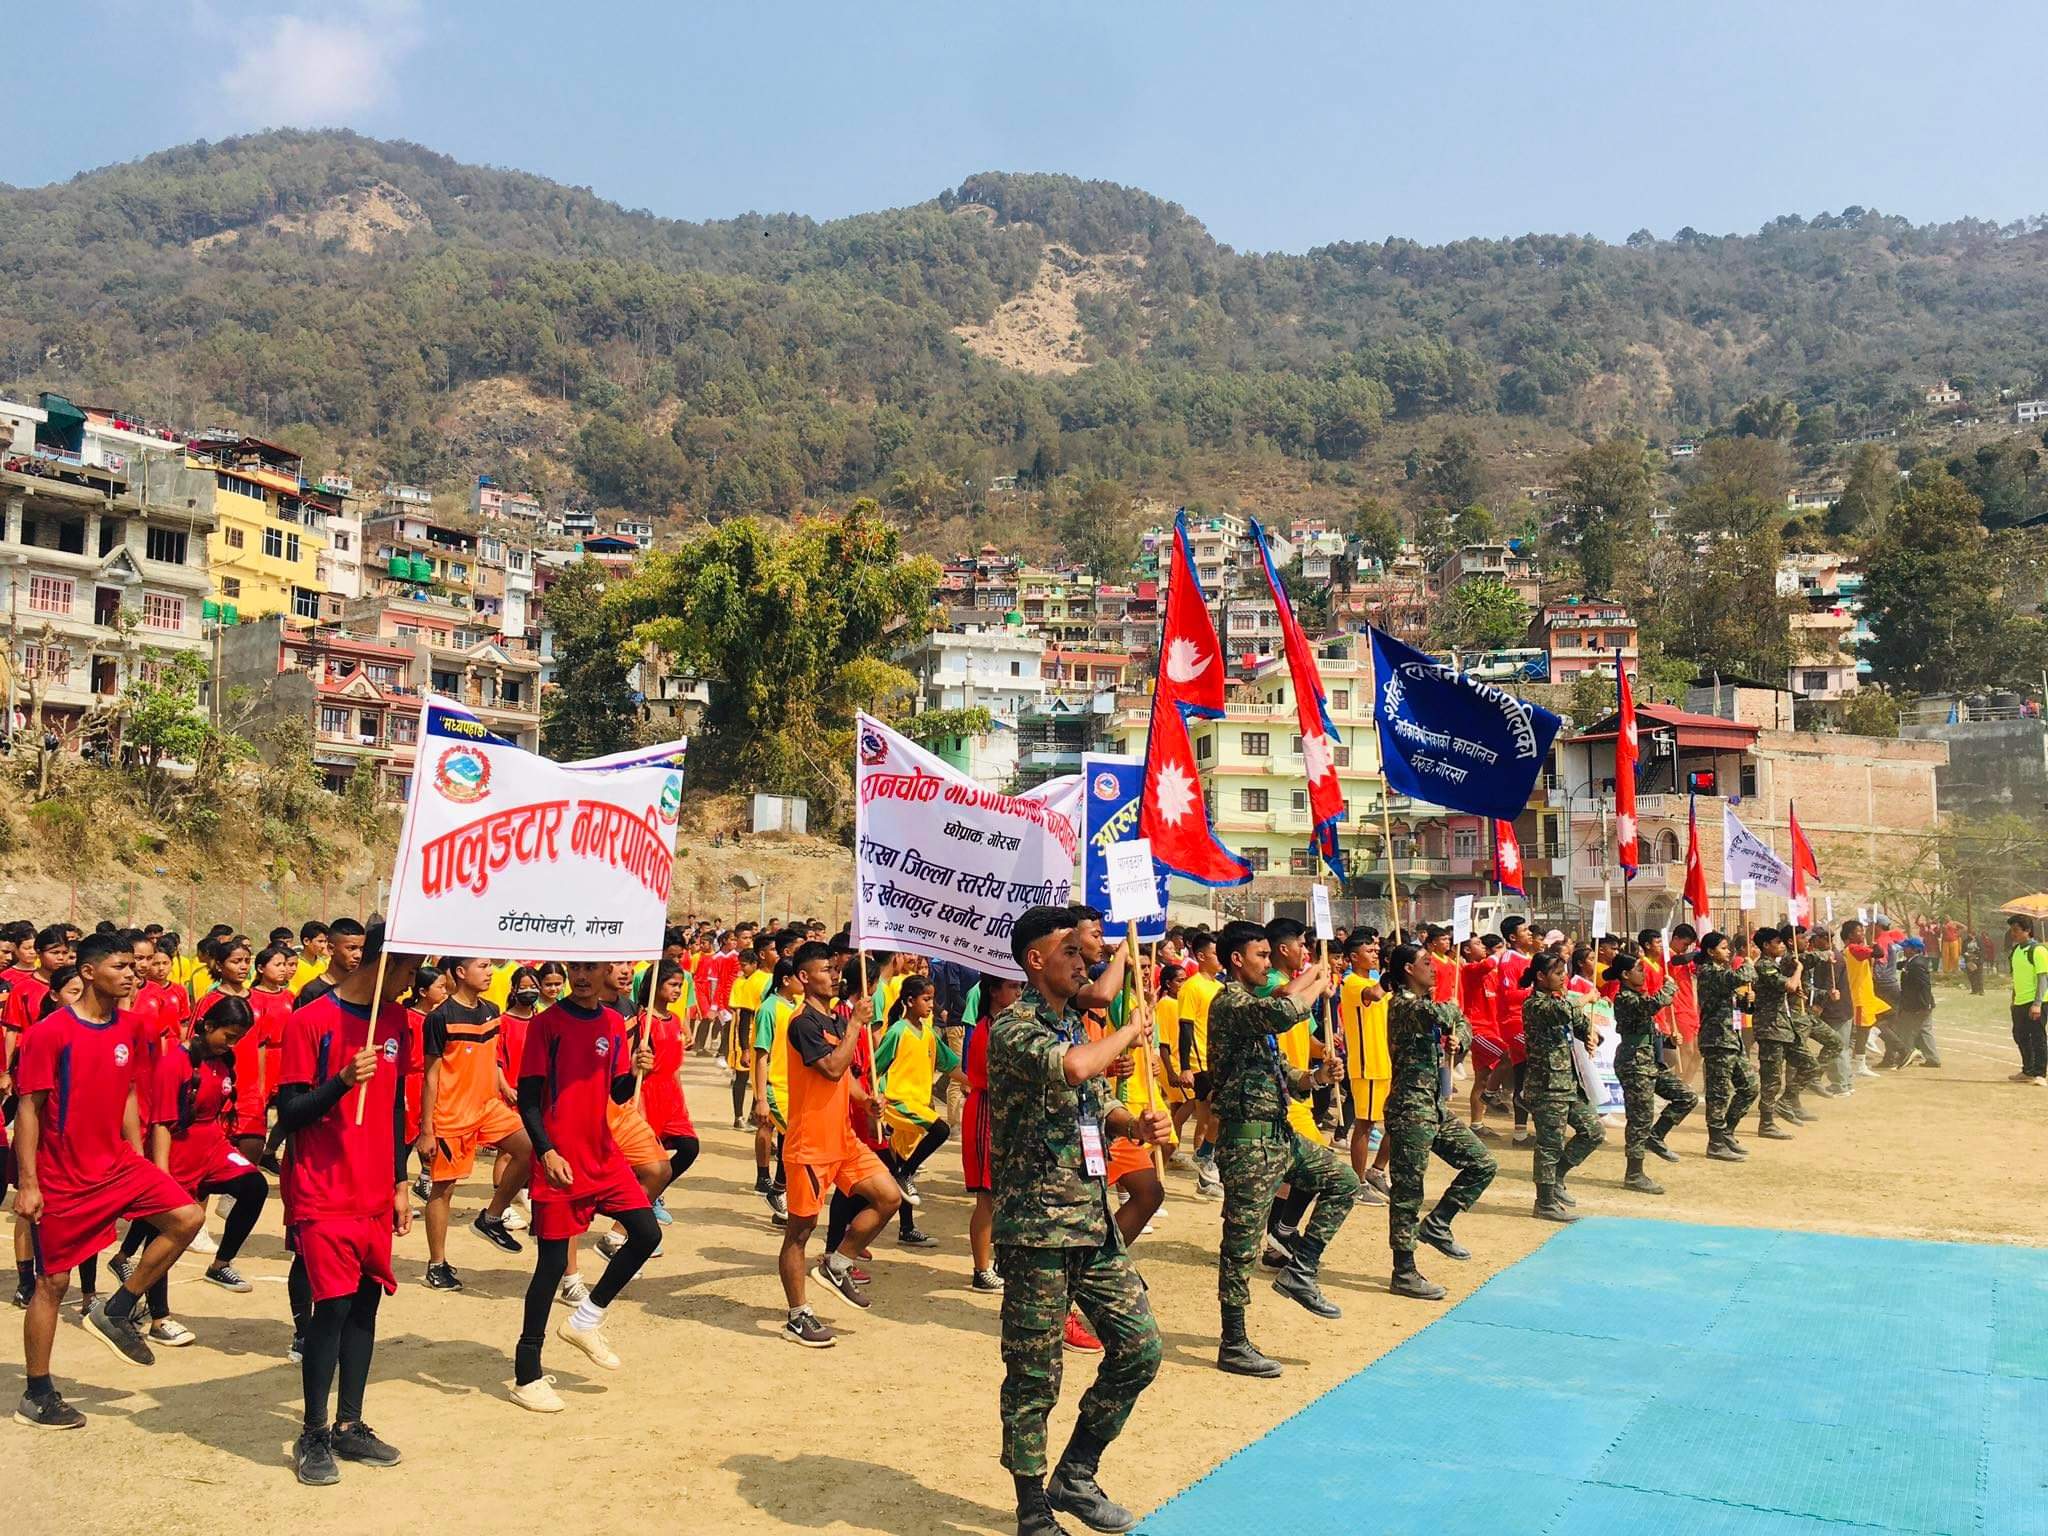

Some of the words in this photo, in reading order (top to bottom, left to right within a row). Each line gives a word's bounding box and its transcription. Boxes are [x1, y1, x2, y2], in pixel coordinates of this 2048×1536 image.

[421, 799, 570, 897] पालुङटार
[570, 799, 673, 904] नगरपालिक
[987, 830, 1022, 852] गोरखा
[899, 847, 956, 887] जिल्ला
[957, 872, 1007, 901] स्तरीय
[1007, 878, 1053, 909] राष्ट्रपति
[497, 908, 577, 938] ठाँटीपोखरी,
[585, 915, 625, 938] गोरखा
[878, 879, 938, 918] खेलकुद
[938, 900, 986, 931] छनौट
[983, 912, 1015, 940] प्रति
[939, 933, 950, 945] १६
